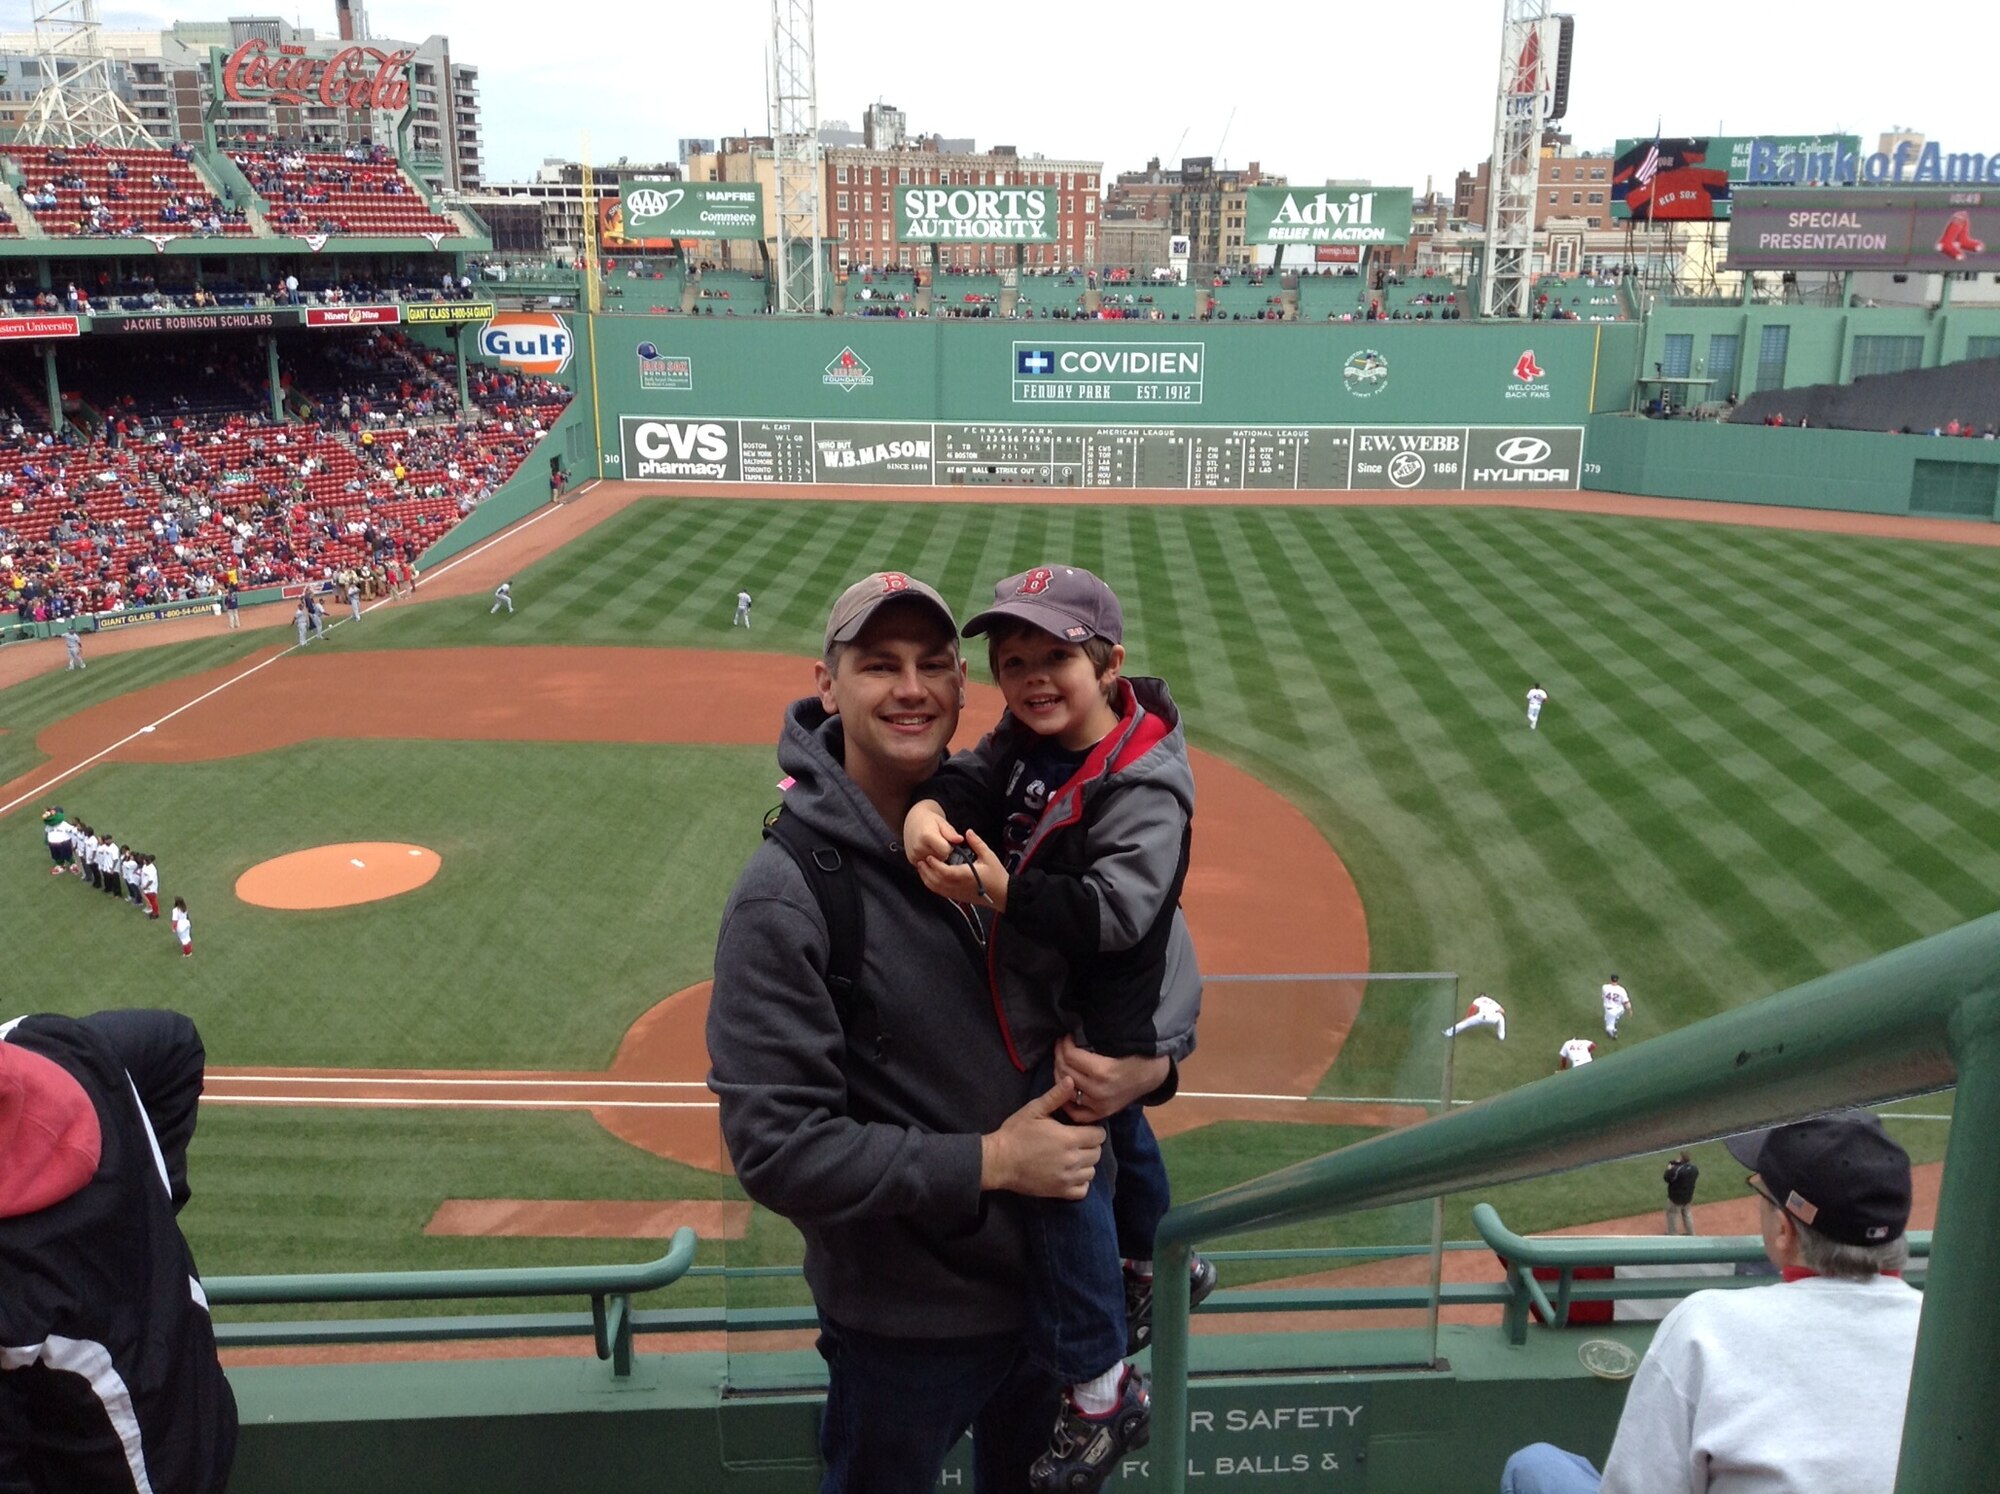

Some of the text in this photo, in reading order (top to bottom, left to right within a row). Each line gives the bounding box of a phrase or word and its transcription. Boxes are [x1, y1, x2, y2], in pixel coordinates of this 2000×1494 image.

[1746, 139, 1857, 182] Bank
[1864, 140, 1913, 182] of
[706, 191, 756, 202] MAPFRE
[1680, 190, 1697, 199] SOX
[629, 190, 666, 216] AAA
[905, 189, 1047, 219] SPORTS
[1271, 192, 1374, 224] Advil
[700, 210, 757, 222] Commerce
[1788, 212, 1862, 228] SPECIAL
[906, 219, 1045, 238] AUTHORITY
[1268, 227, 1386, 240] RELIEF IN ACTION
[1759, 233, 1887, 250] PRESENTATION
[324, 311, 348, 321] Ninety
[362, 310, 380, 319] Nine
[409, 308, 428, 320] GIANT
[429, 307, 450, 319] GLASS
[474, 306, 491, 317] GIANT
[0, 321, 74, 333] stern University
[123, 313, 273, 331] JACKIE ROBINSON SCHOLARS
[485, 330, 566, 355] Gulf
[1060, 351, 1198, 374] COVIDIEN
[1023, 384, 1191, 400] FENWAY PARK EST. 1912
[761, 423, 791, 431] AL EAST
[634, 421, 728, 461] CVS
[817, 440, 852, 449] WHO BUT
[1359, 435, 1397, 451] F.W.
[1398, 435, 1460, 451] WEBB
[604, 454, 620, 464] 310
[954, 451, 978, 459] BOSTON
[638, 460, 727, 479] pharmacy
[955, 466, 967, 474] BAT
[972, 466, 988, 474] BALL
[995, 466, 1018, 474] STRIKE
[1357, 462, 1458, 474] Since 1866
[1473, 468, 1569, 482] HYUNDAI
[1584, 463, 1601, 474] 379
[879, 572, 910, 593] B
[1016, 568, 1054, 596] B
[101, 615, 127, 628] GIANT
[127, 611, 156, 623] GLASS
[1605, 991, 1620, 1002] 42
[1225, 1405, 1364, 1432] SAFETY
[1122, 1452, 1340, 1479] FL BALLS &
